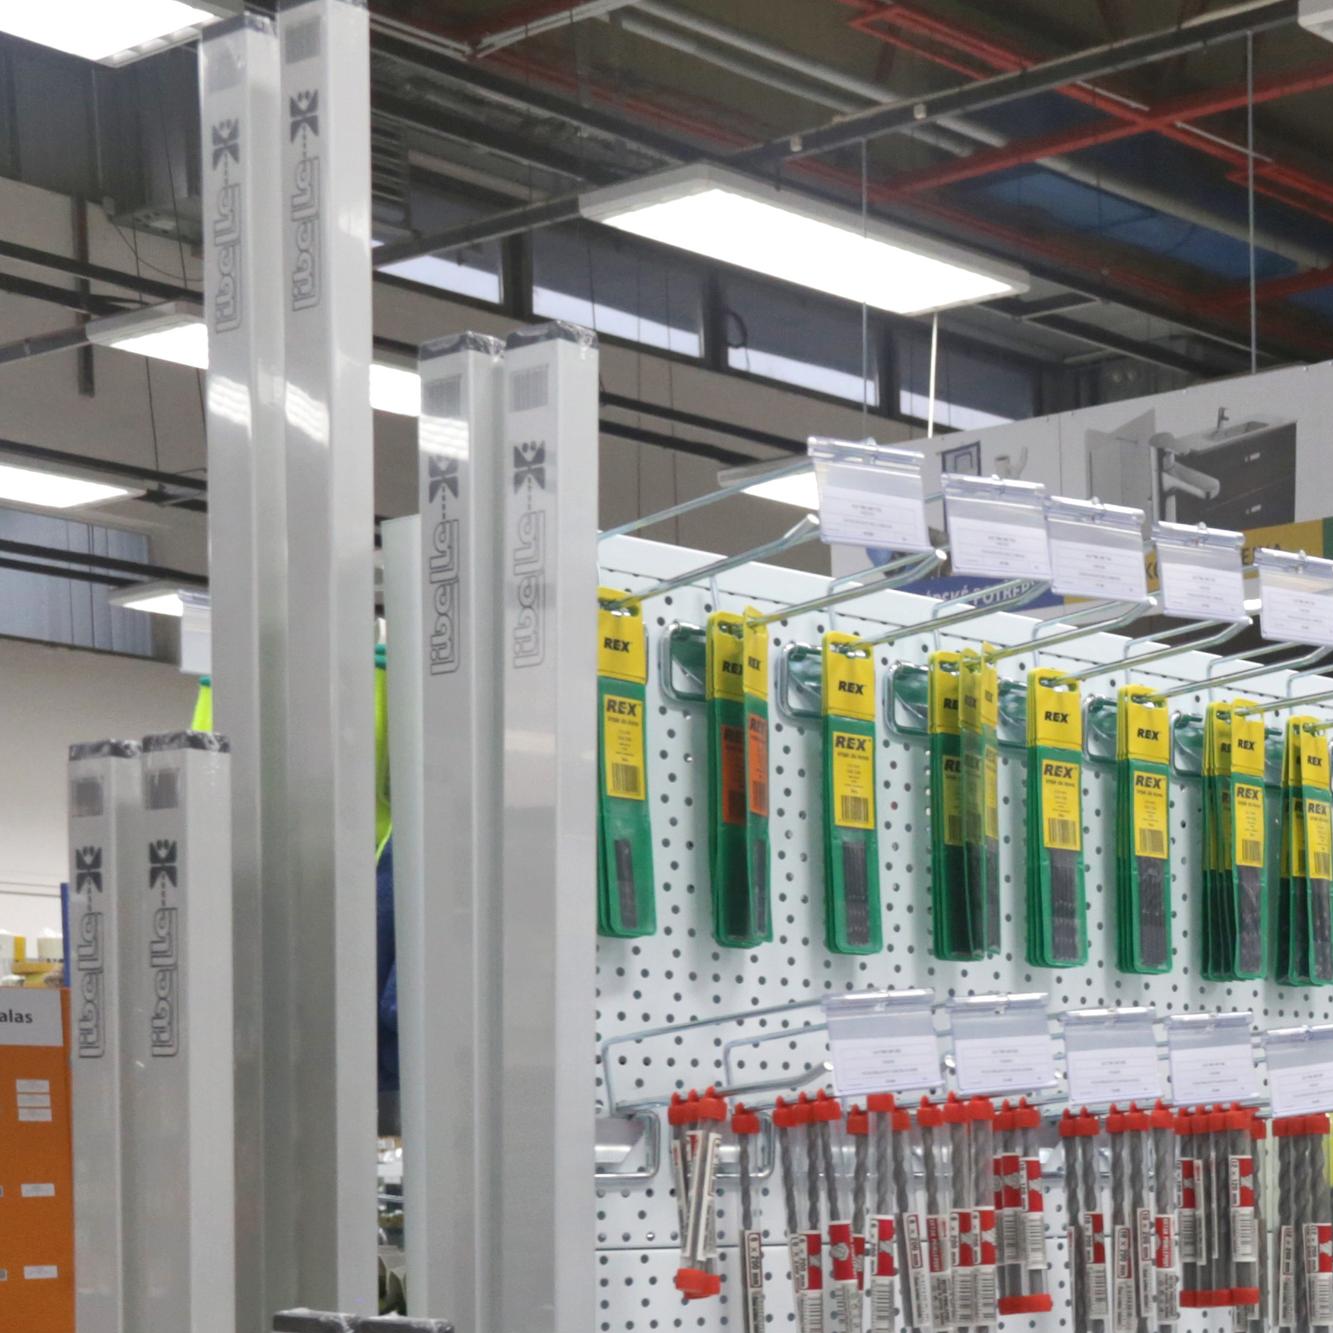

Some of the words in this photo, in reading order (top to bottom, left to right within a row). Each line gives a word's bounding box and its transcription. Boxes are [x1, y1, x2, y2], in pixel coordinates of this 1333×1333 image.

[604, 637, 630, 654] REX
[838, 680, 865, 695] REX
[606, 699, 638, 718] REX
[1044, 711, 1069, 724] REX
[1137, 728, 1160, 741] REX
[835, 735, 867, 751] REX
[1237, 739, 1255, 751] REX
[1307, 755, 1323, 767] REX
[1043, 764, 1073, 779] REX
[1135, 775, 1161, 790] REX
[1237, 786, 1260, 800] REX
[1307, 803, 1328, 816] REX
